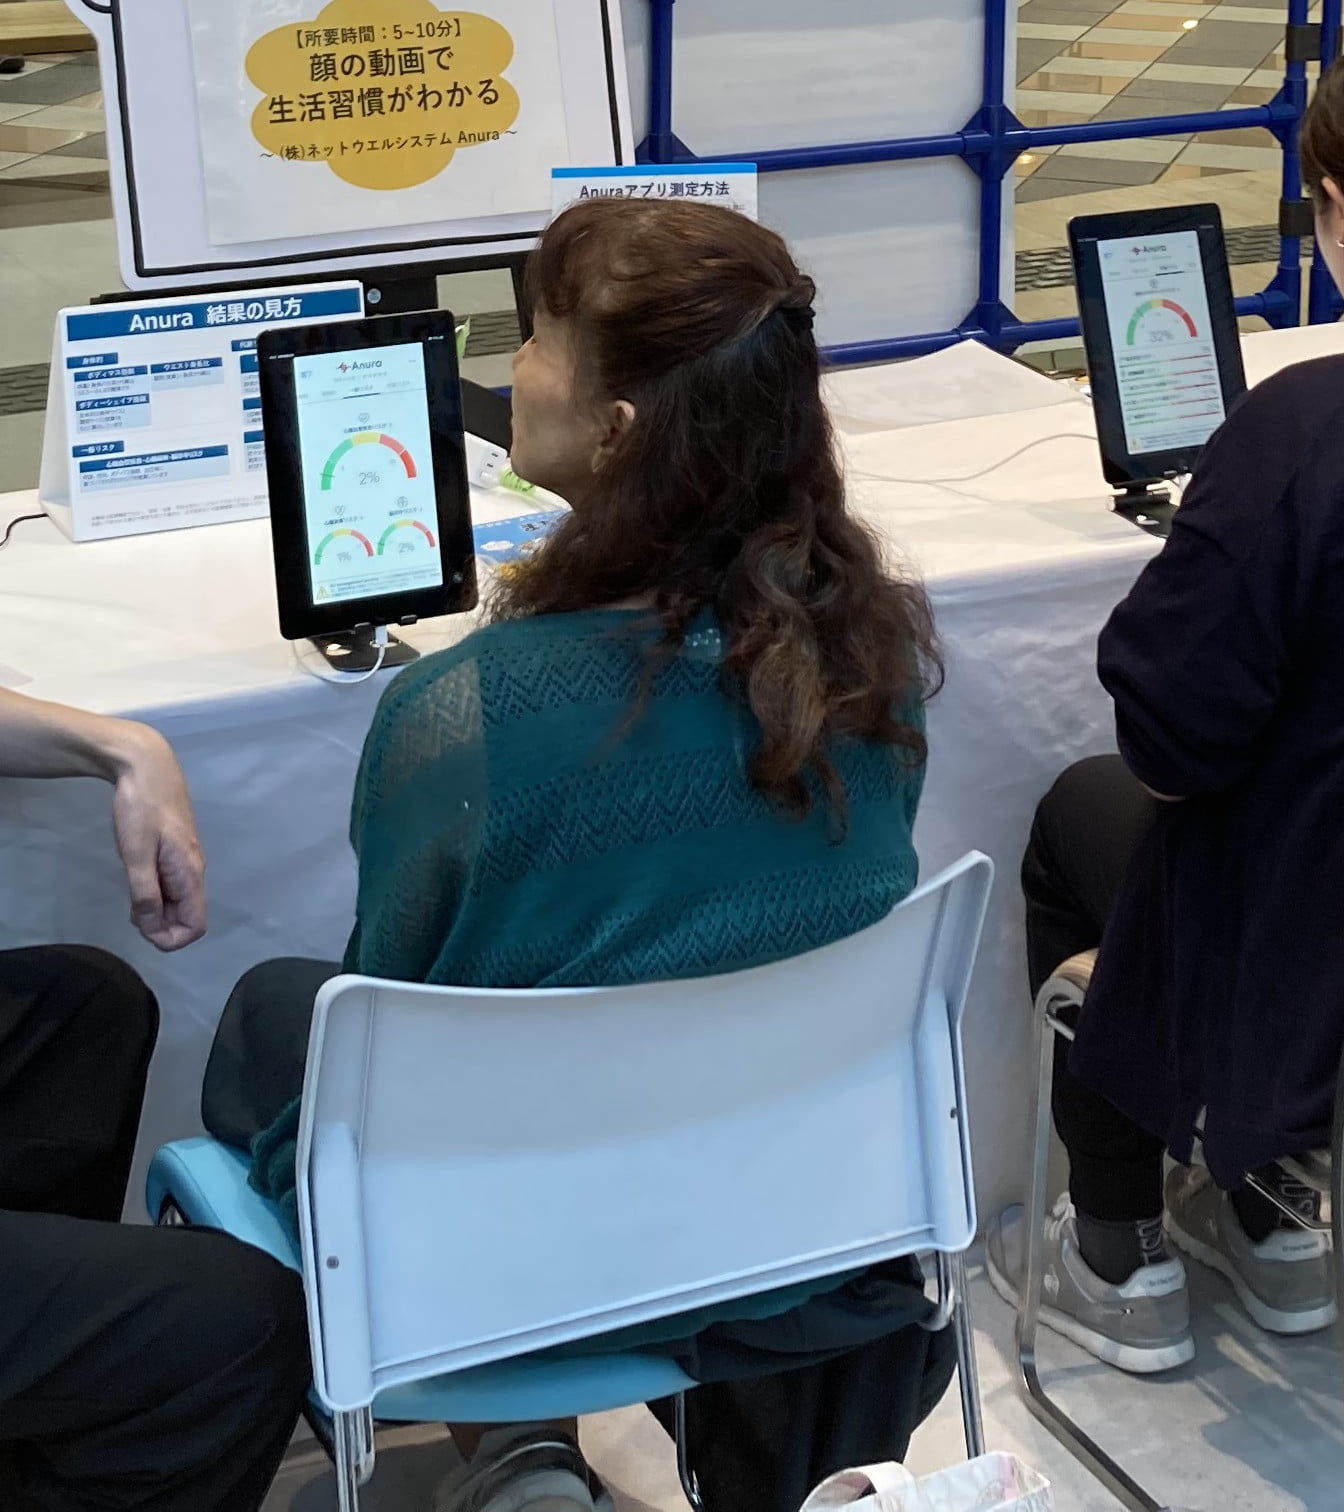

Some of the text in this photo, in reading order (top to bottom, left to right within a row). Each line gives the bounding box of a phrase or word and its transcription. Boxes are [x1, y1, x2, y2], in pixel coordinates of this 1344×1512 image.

[309, 45, 454, 82] 顔の動画で
[268, 78, 500, 124] 生活習慣がわかる
[457, 128, 500, 145] Anura
[579, 180, 730, 199] Anuraアプリ測定方法
[130, 297, 303, 333] Anura 結果の見方
[351, 359, 383, 371] Anura
[358, 471, 380, 486] 2%
